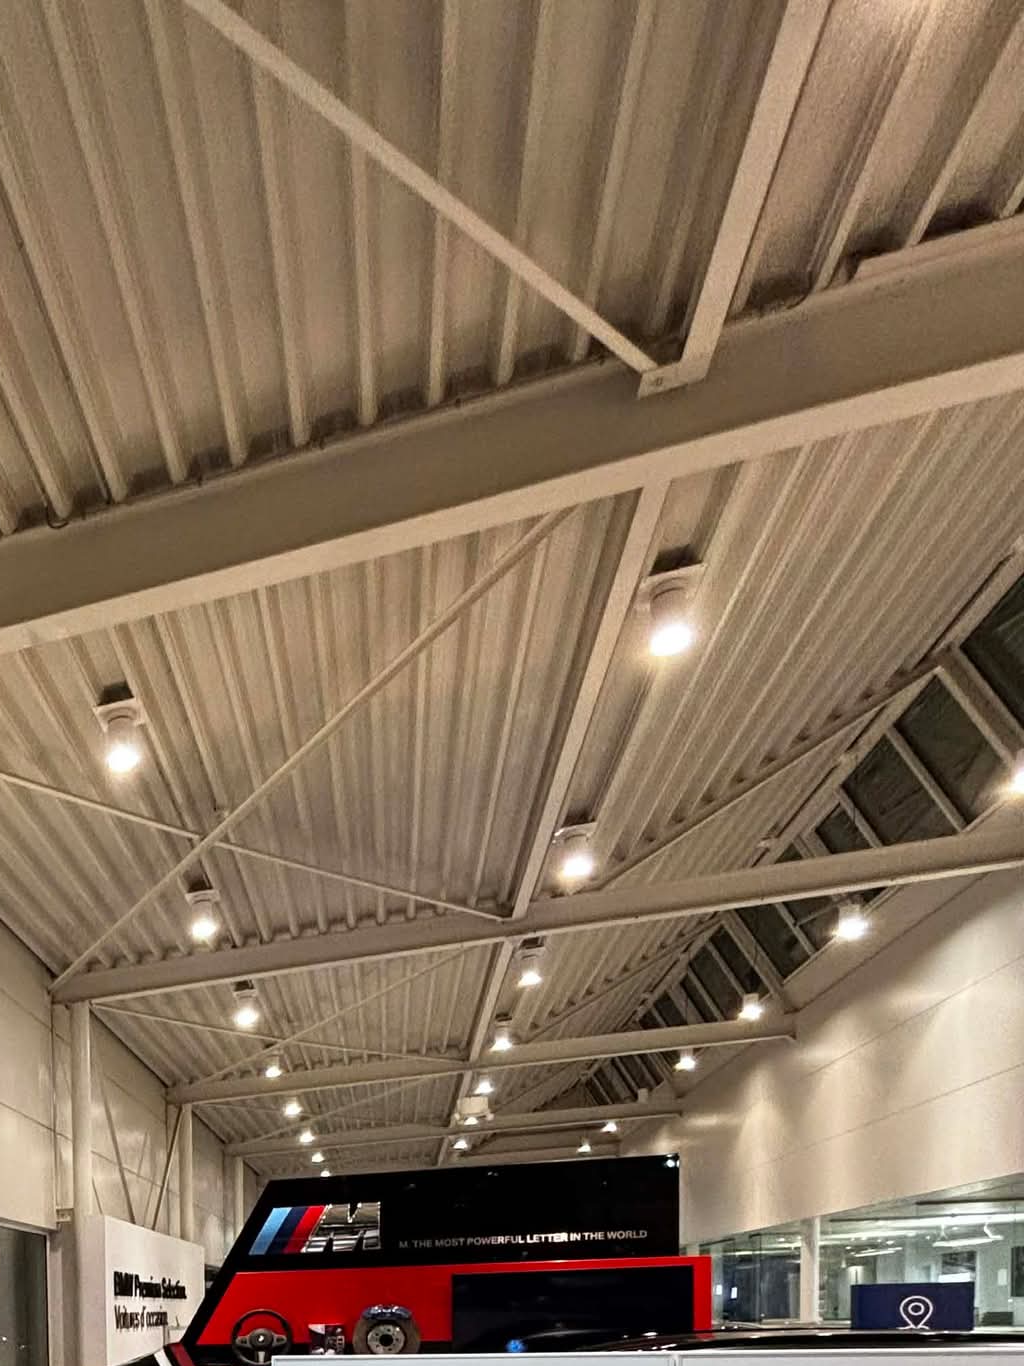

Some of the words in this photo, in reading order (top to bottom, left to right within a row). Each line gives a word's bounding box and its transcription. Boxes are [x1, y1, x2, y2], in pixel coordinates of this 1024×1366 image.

[412, 1239, 433, 1248] THE
[435, 1237, 465, 1247] MOST
[466, 1235, 525, 1246] POWERFUL
[526, 1232, 569, 1243] LETTER
[569, 1232, 581, 1242] IN
[582, 1231, 605, 1241] THE
[606, 1230, 648, 1240] WORLD
